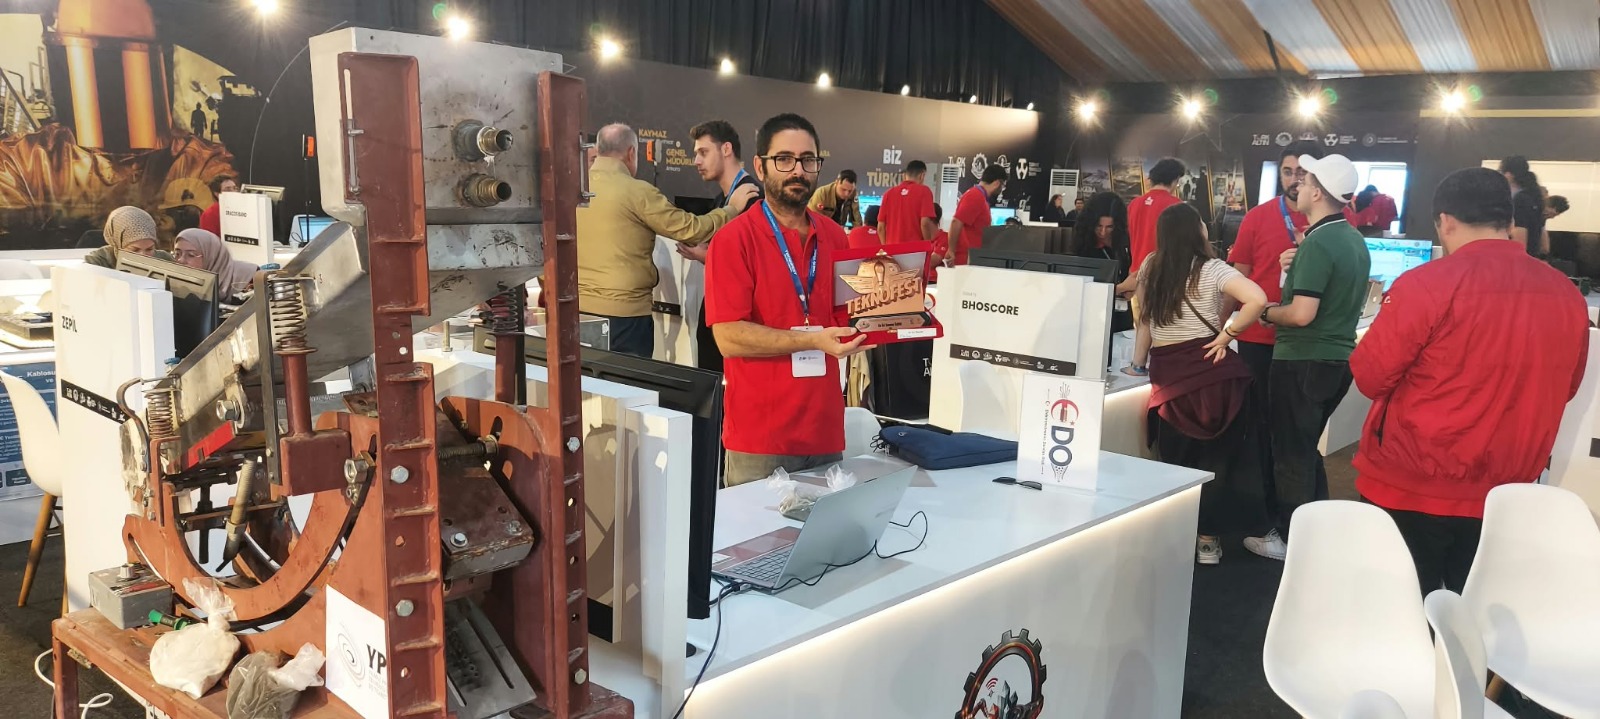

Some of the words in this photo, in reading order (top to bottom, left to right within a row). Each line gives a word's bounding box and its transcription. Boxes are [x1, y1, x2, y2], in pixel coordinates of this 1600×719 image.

[639, 129, 667, 138] KAYMAZ
[666, 149, 687, 157] GENEL
[883, 145, 902, 164] BİZ
[867, 168, 905, 187] TÜRKİ
[845, 277, 922, 316] TEKNOFEST
[962, 300, 1019, 316] BHOSCORE
[61, 315, 78, 333] ZEPİL
